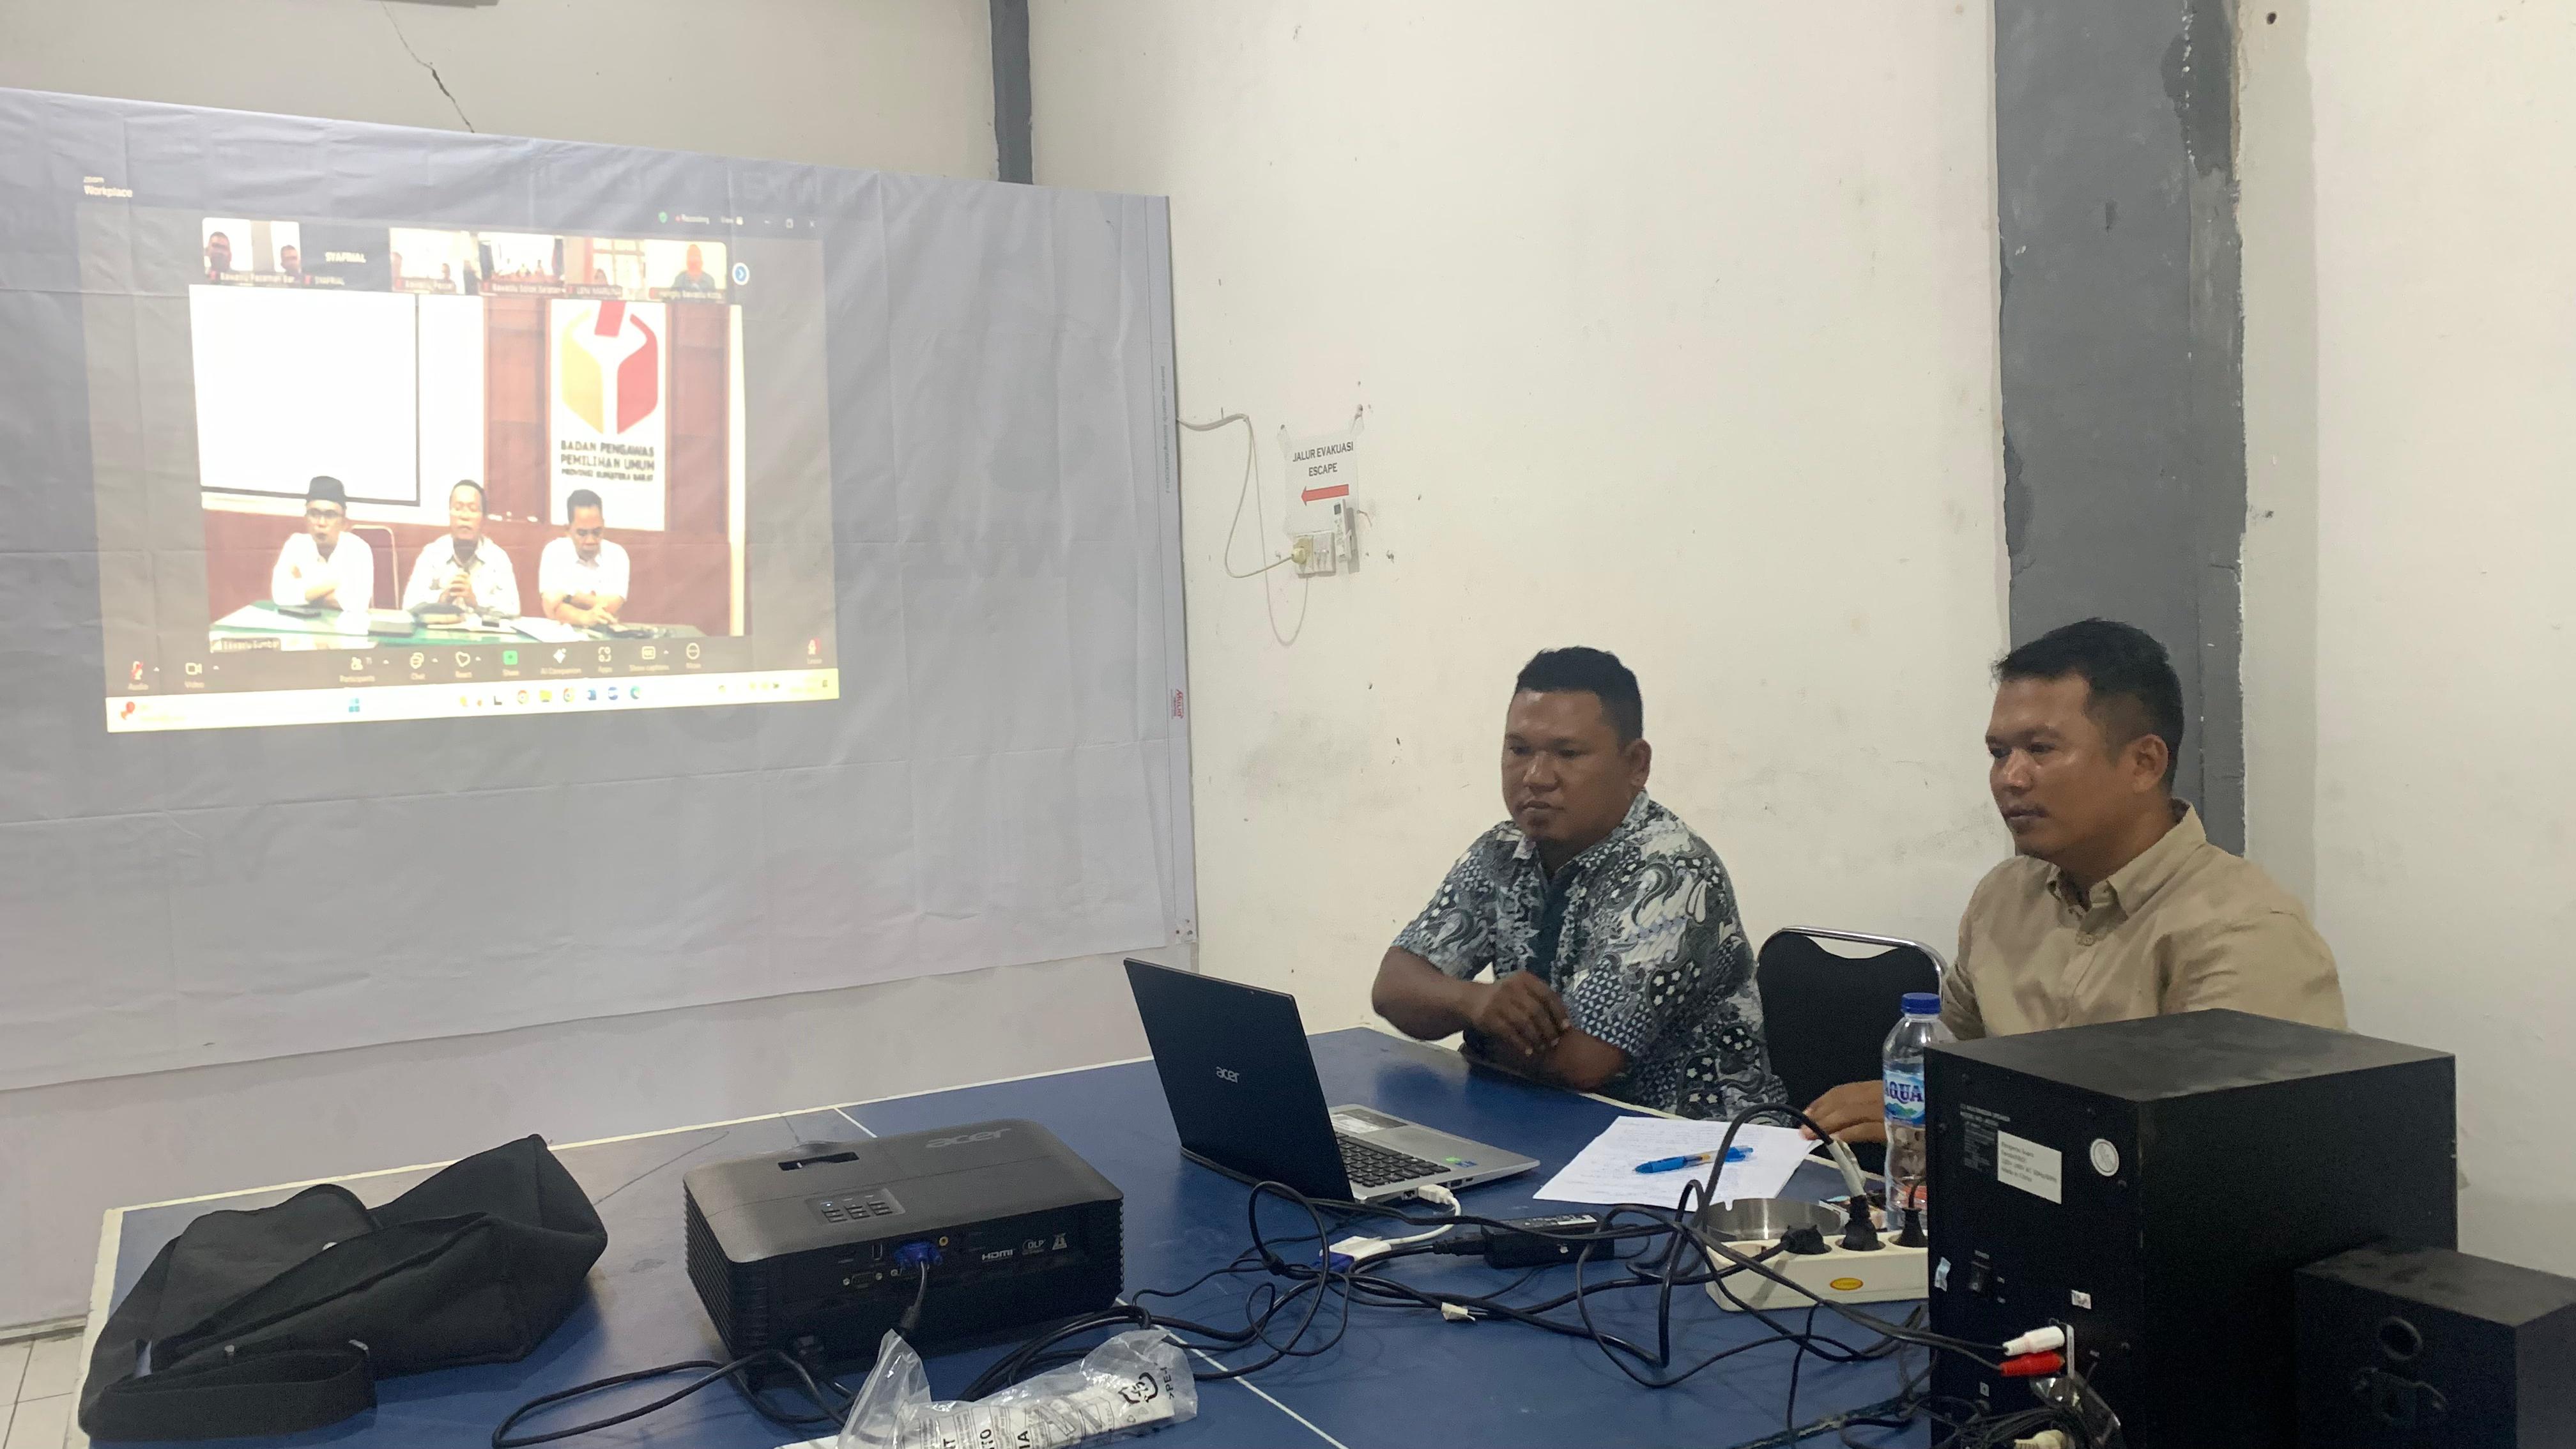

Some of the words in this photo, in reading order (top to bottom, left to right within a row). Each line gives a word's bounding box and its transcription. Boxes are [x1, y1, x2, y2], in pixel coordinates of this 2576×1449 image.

[560, 440, 596, 451] BADAN
[600, 442, 655, 457] PENGAWAS
[1292, 449, 1315, 462] JALUR
[1317, 441, 1354, 457] EVAKUASI
[560, 454, 620, 468] PEMILIHAN
[624, 459, 656, 471] UMUM
[1308, 463, 1338, 477] ESCAPE
[1216, 1066, 1240, 1084] acer
[1885, 1079, 1924, 1104] AQUA
[925, 1128, 1012, 1149] acer
[1027, 1239, 1045, 1250] DLP
[981, 1248, 1013, 1261] HDMI
